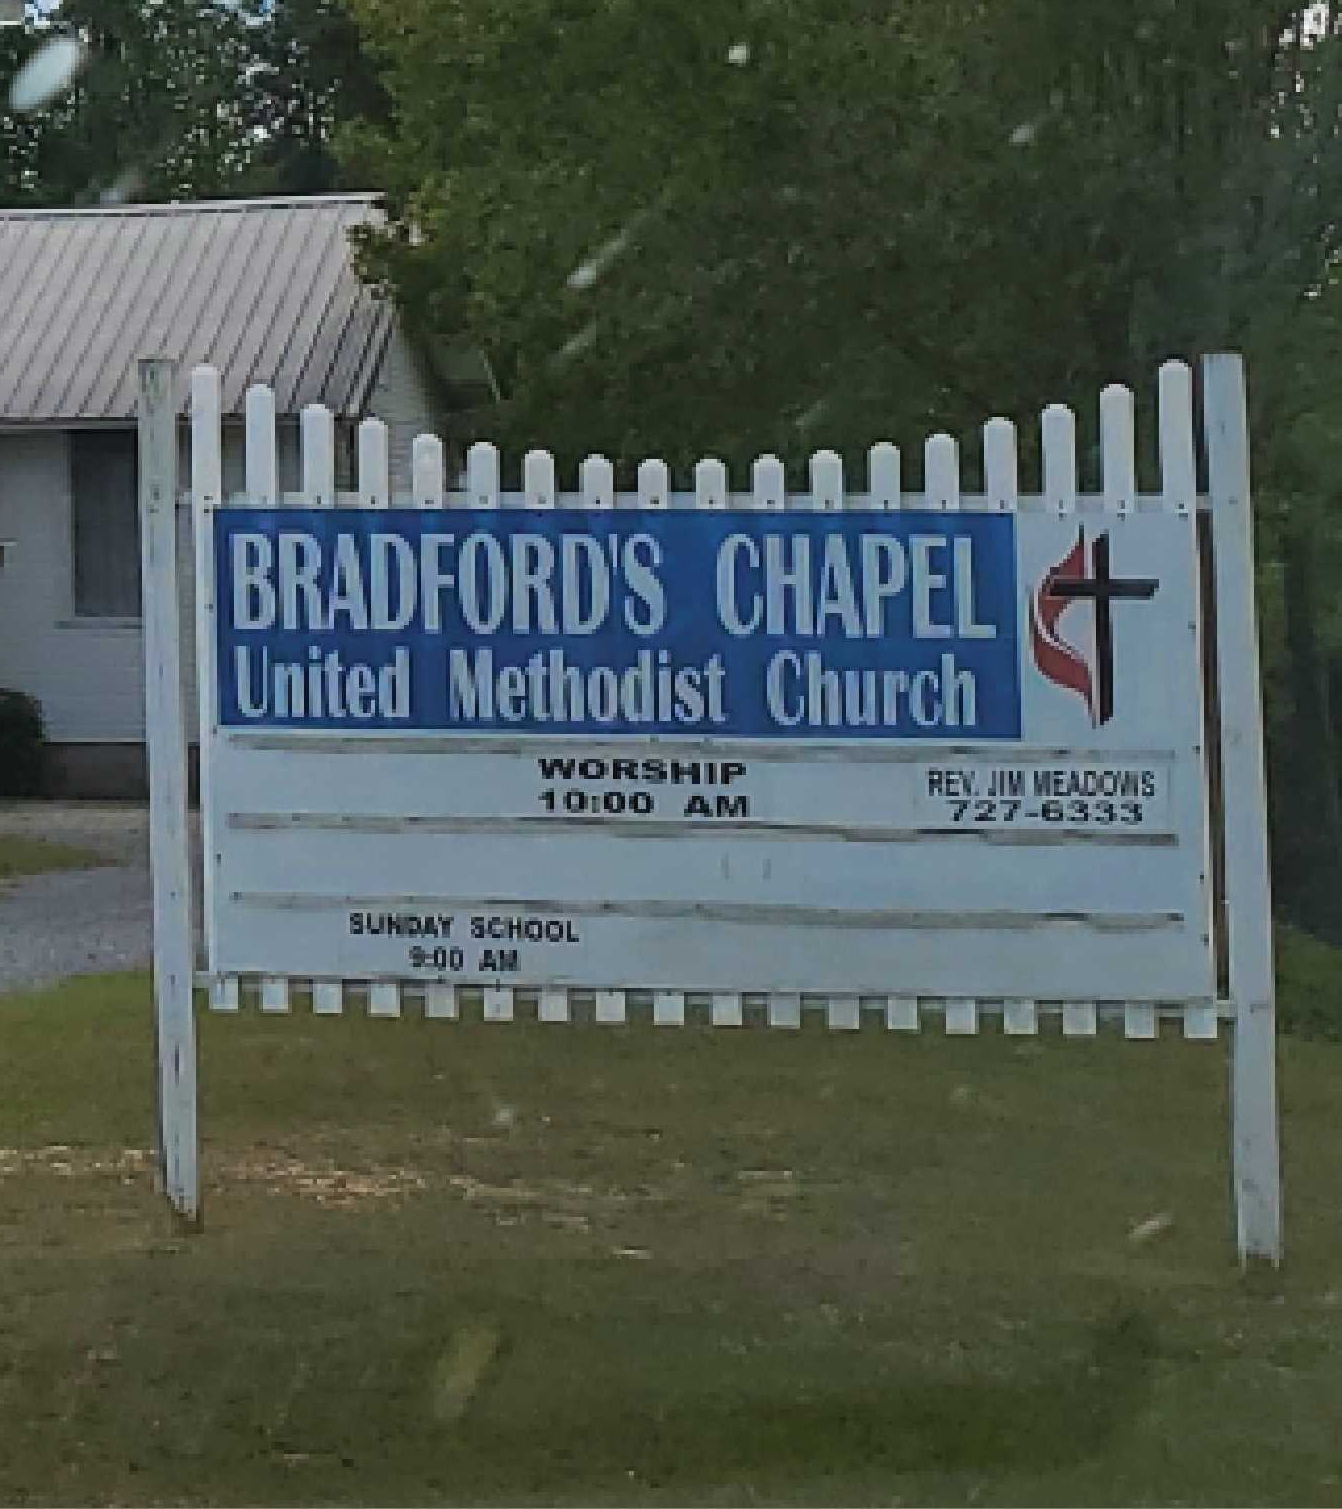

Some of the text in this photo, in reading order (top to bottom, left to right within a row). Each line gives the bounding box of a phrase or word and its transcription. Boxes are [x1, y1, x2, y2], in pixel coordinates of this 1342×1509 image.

[231, 533, 997, 638] BRADFORD'S CHAPEL
[236, 645, 976, 726] United Methodist Church
[539, 758, 746, 784] WORSHIP
[926, 769, 1155, 797] REV. JIM MEADOWS
[539, 789, 750, 817] 10:00 AM
[946, 799, 1143, 824] 727-6333
[349, 912, 579, 942] SUNDAY SCHOOL
[409, 946, 520, 971] 9:00 AM
